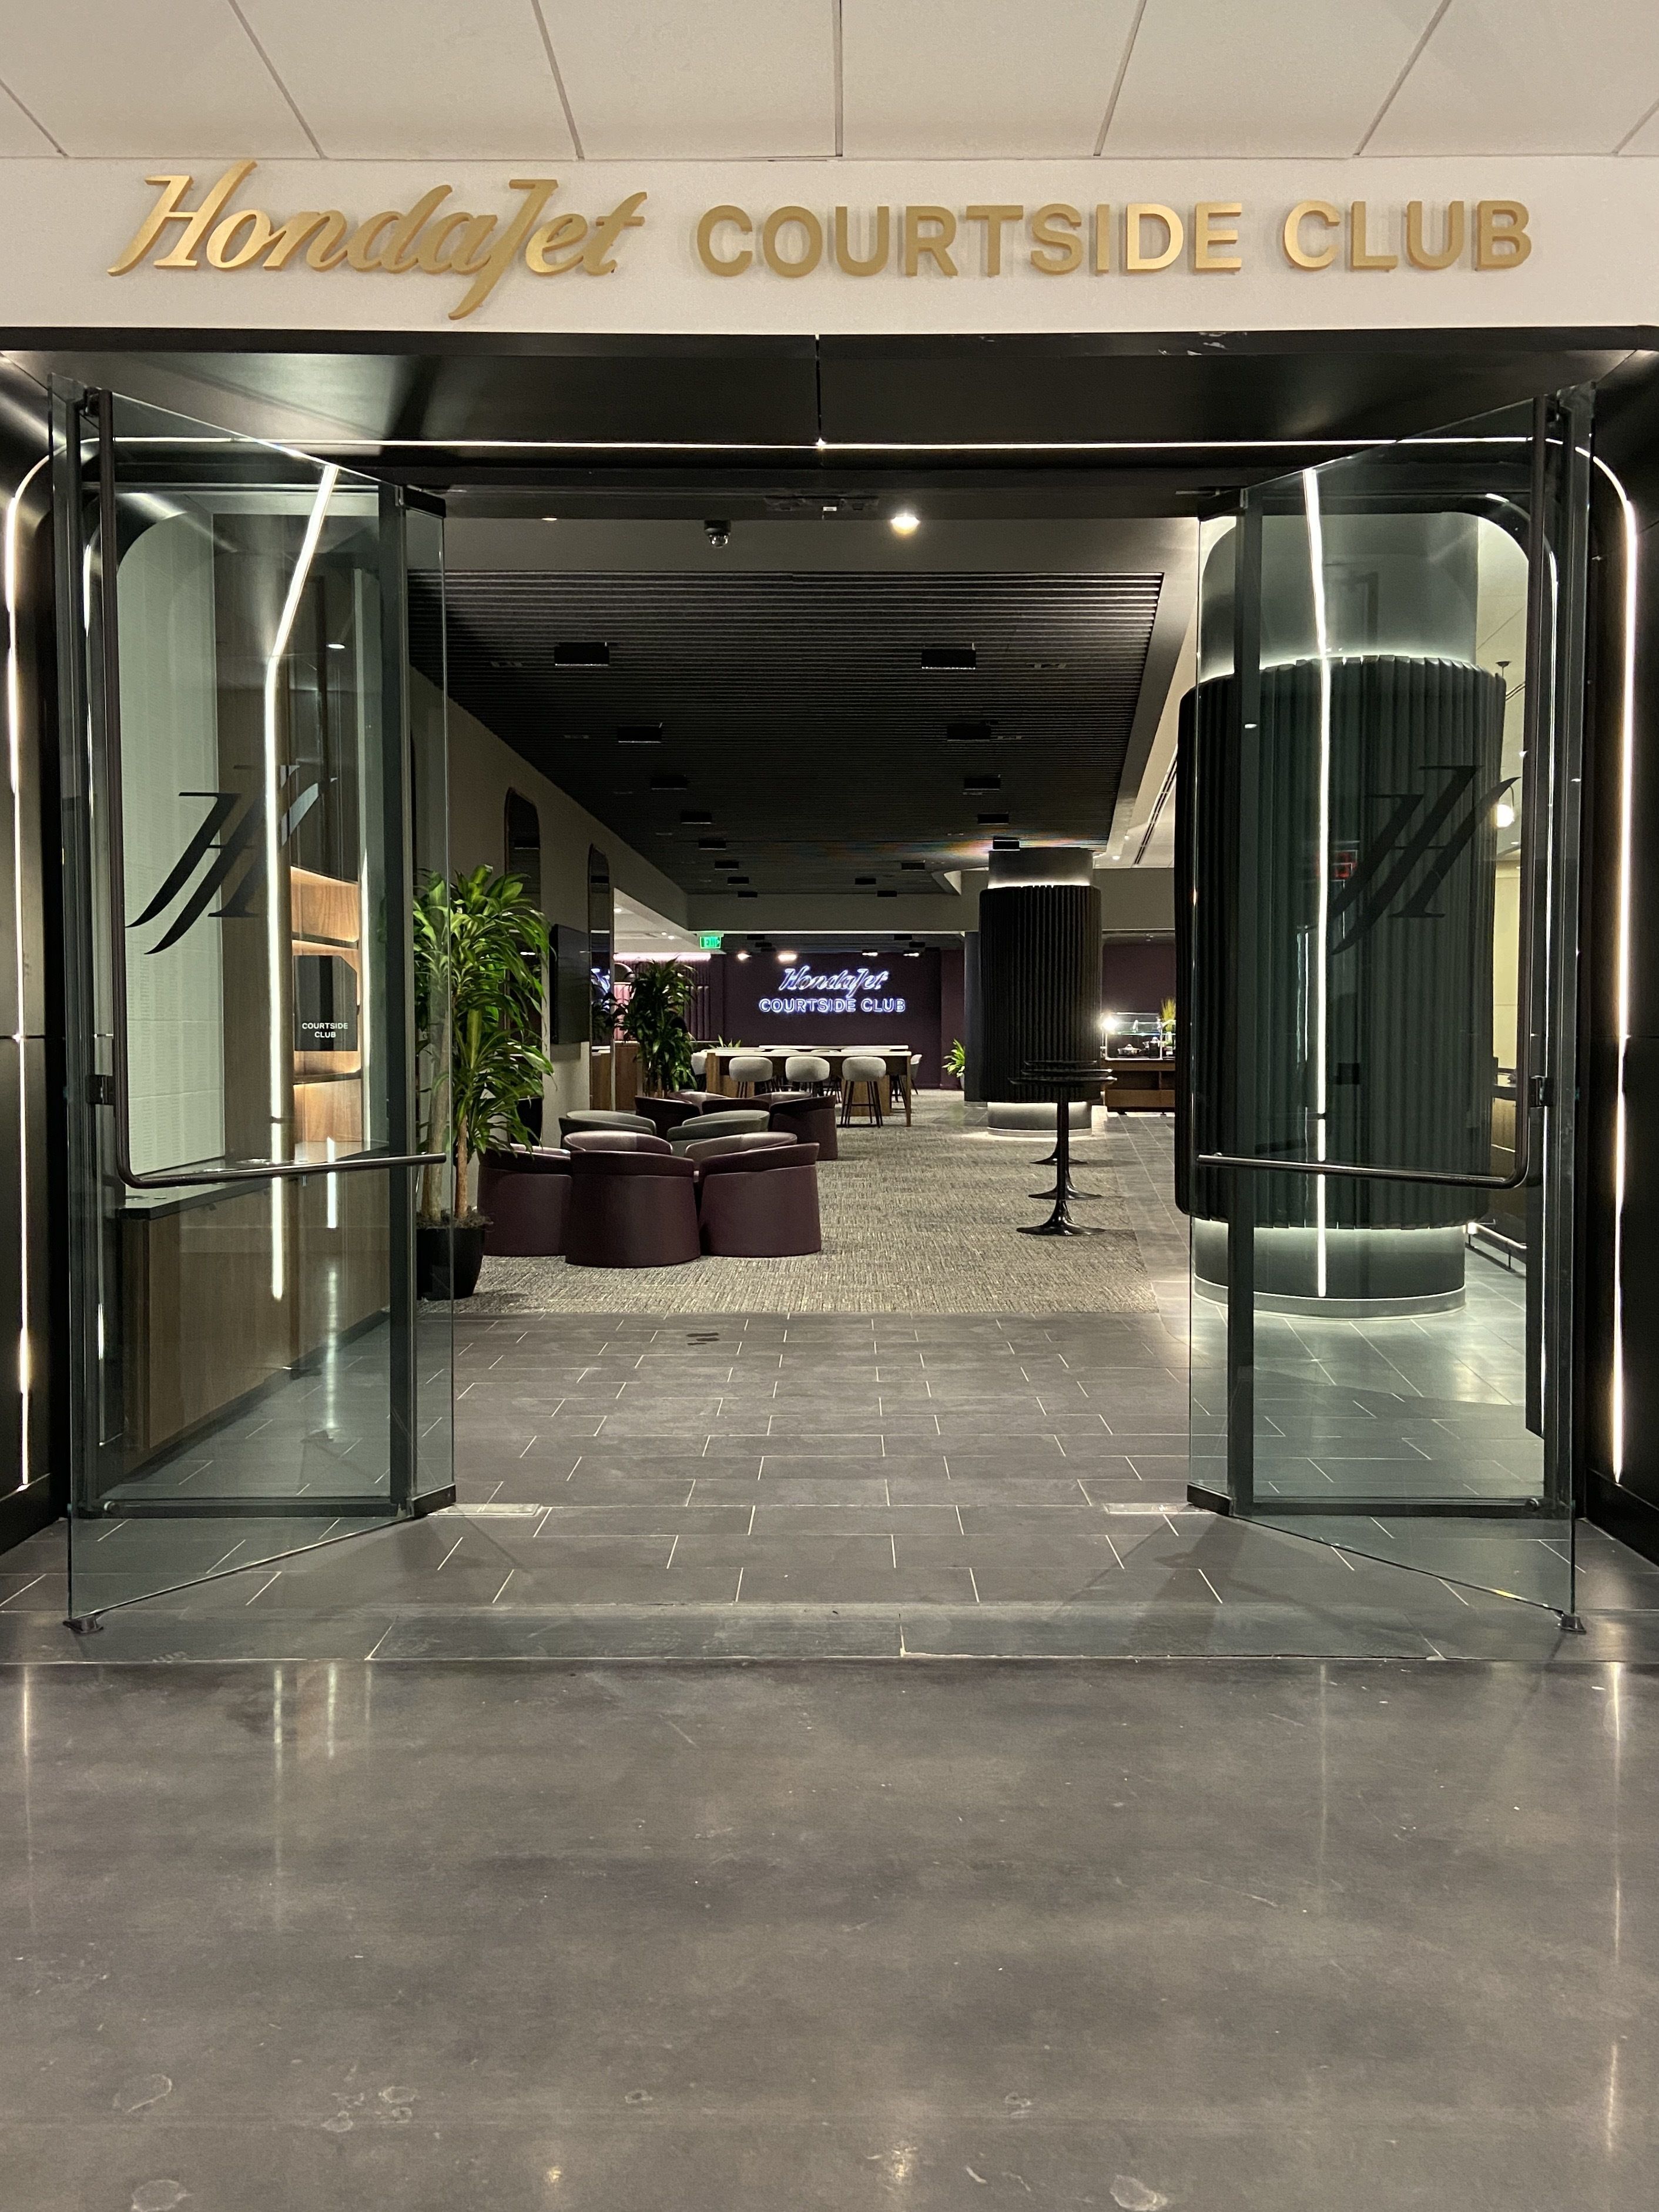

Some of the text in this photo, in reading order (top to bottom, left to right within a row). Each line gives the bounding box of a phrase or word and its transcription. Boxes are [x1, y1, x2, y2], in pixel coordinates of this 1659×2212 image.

[106, 159, 1533, 320] HondaJet COURTSIDE CLUB
[778, 965, 890, 998] HondaJet
[759, 998, 906, 1013] COURTSIDE CLUB
